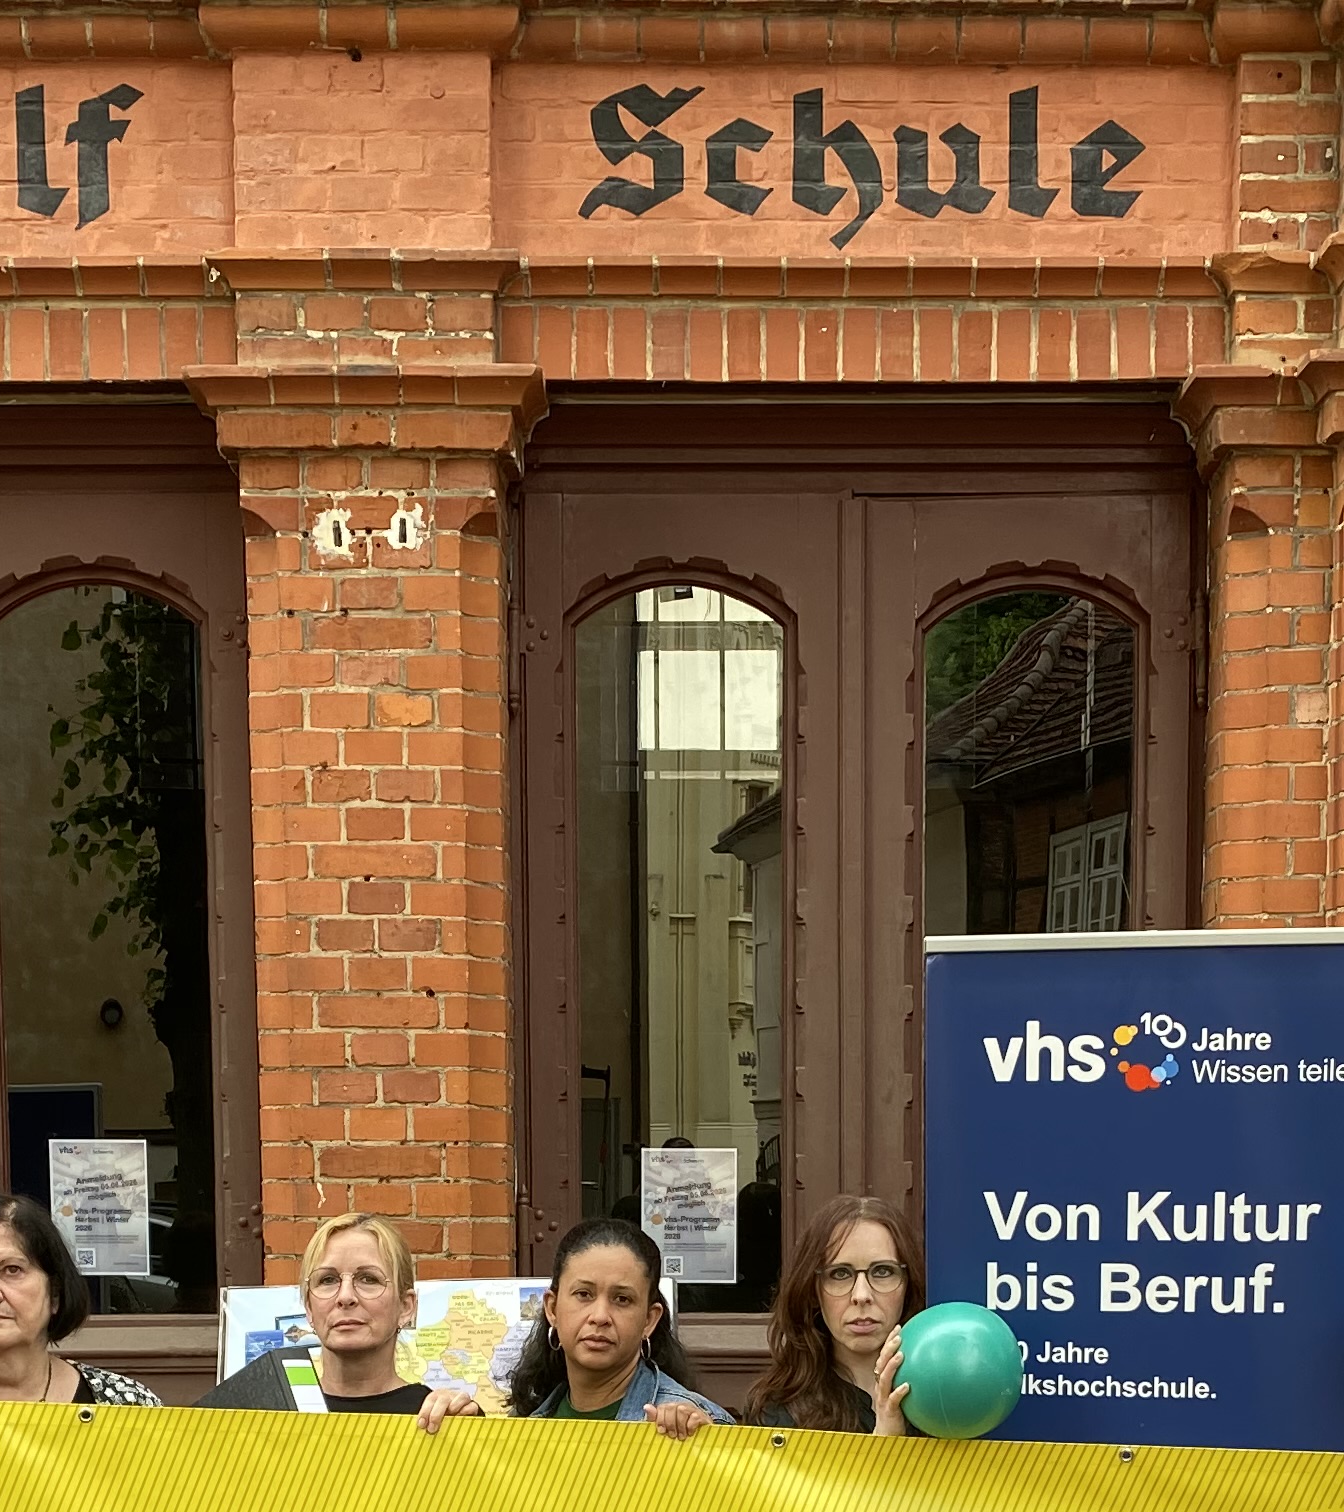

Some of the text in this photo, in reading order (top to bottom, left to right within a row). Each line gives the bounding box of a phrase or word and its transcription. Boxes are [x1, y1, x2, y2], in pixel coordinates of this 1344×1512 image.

[578, 83, 1145, 250] Schule
[983, 1021, 1106, 1083] vhs
[1192, 1028, 1272, 1051] Jahre
[1192, 1059, 1288, 1084] Wissen
[983, 1191, 1321, 1242] Von Kultur
[986, 1262, 1285, 1313] bis Beruf.
[1036, 1341, 1109, 1364] Jahre
[1021, 1374, 1217, 1400] lkshochschule.
